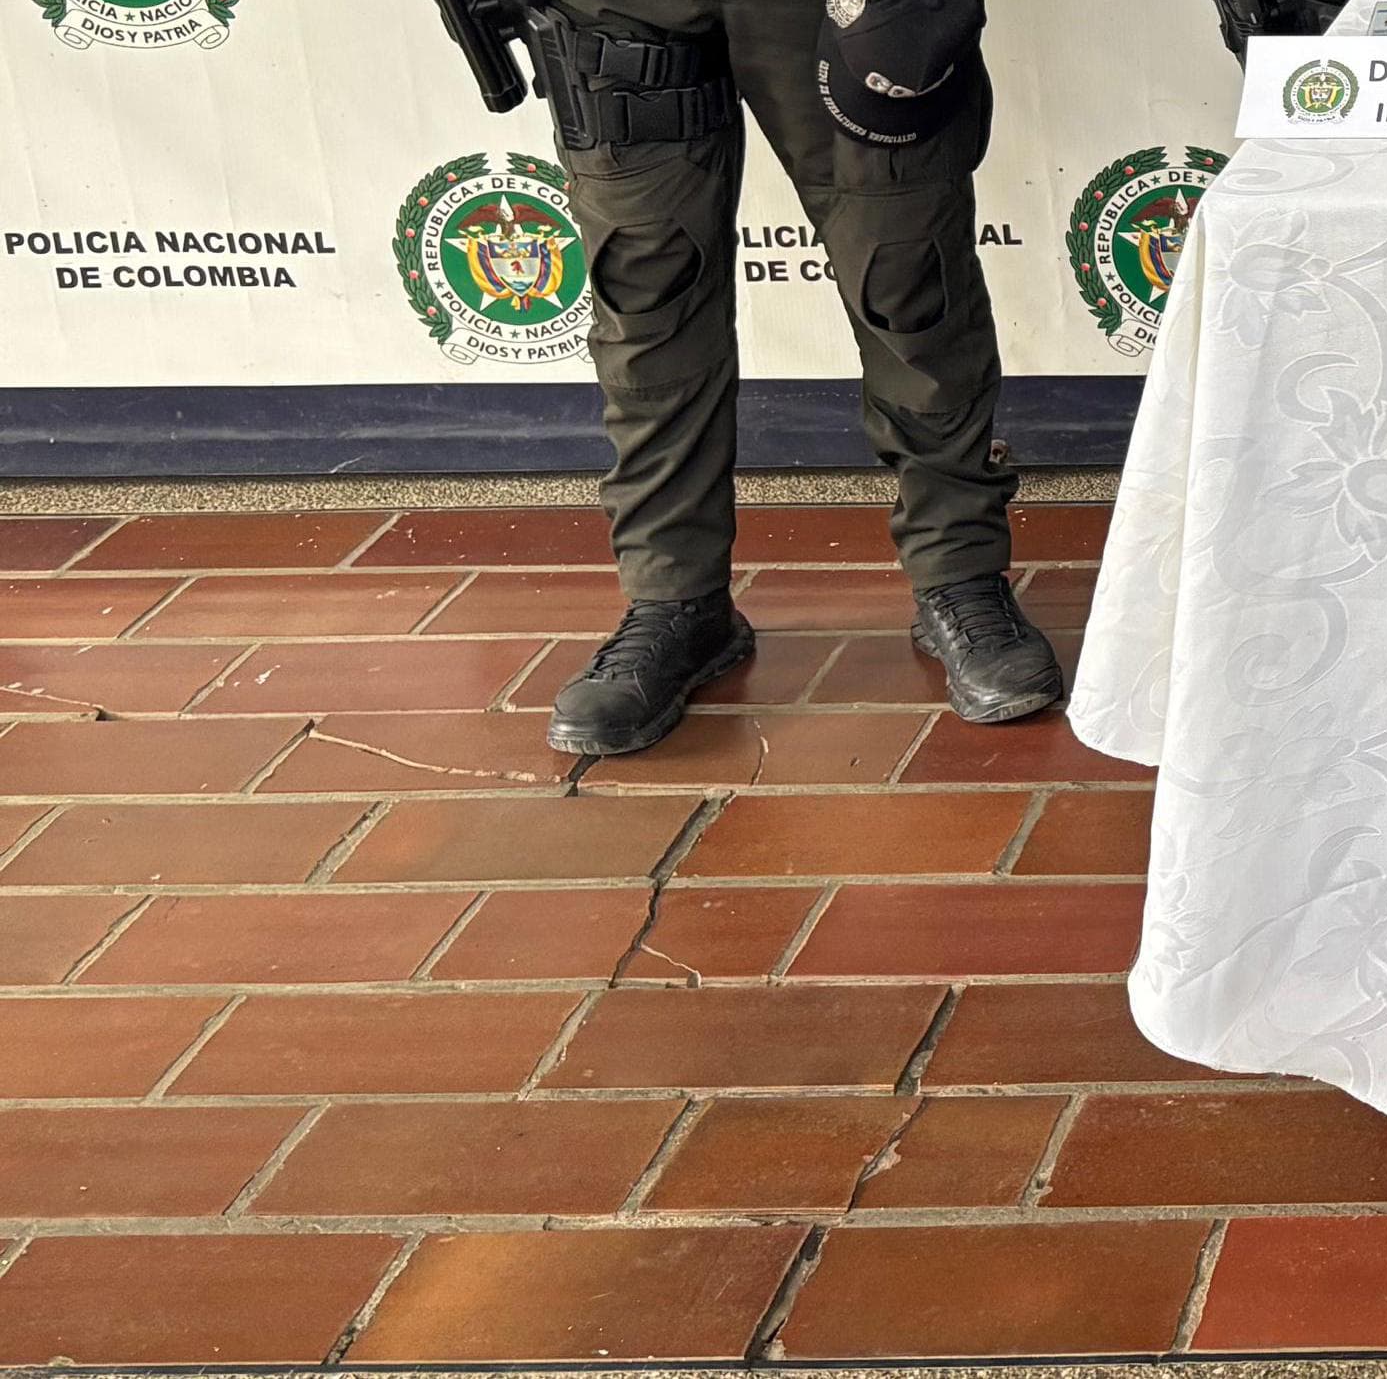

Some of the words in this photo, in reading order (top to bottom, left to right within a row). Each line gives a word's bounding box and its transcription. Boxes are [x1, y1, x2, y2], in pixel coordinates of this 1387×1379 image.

[143, 19, 202, 43] PATRIA
[5, 231, 147, 254] POLICIA
[155, 232, 335, 254] NACIONAL
[56, 267, 102, 288] DE
[113, 266, 296, 287] COLOMBIA
[744, 261, 789, 282] DE
